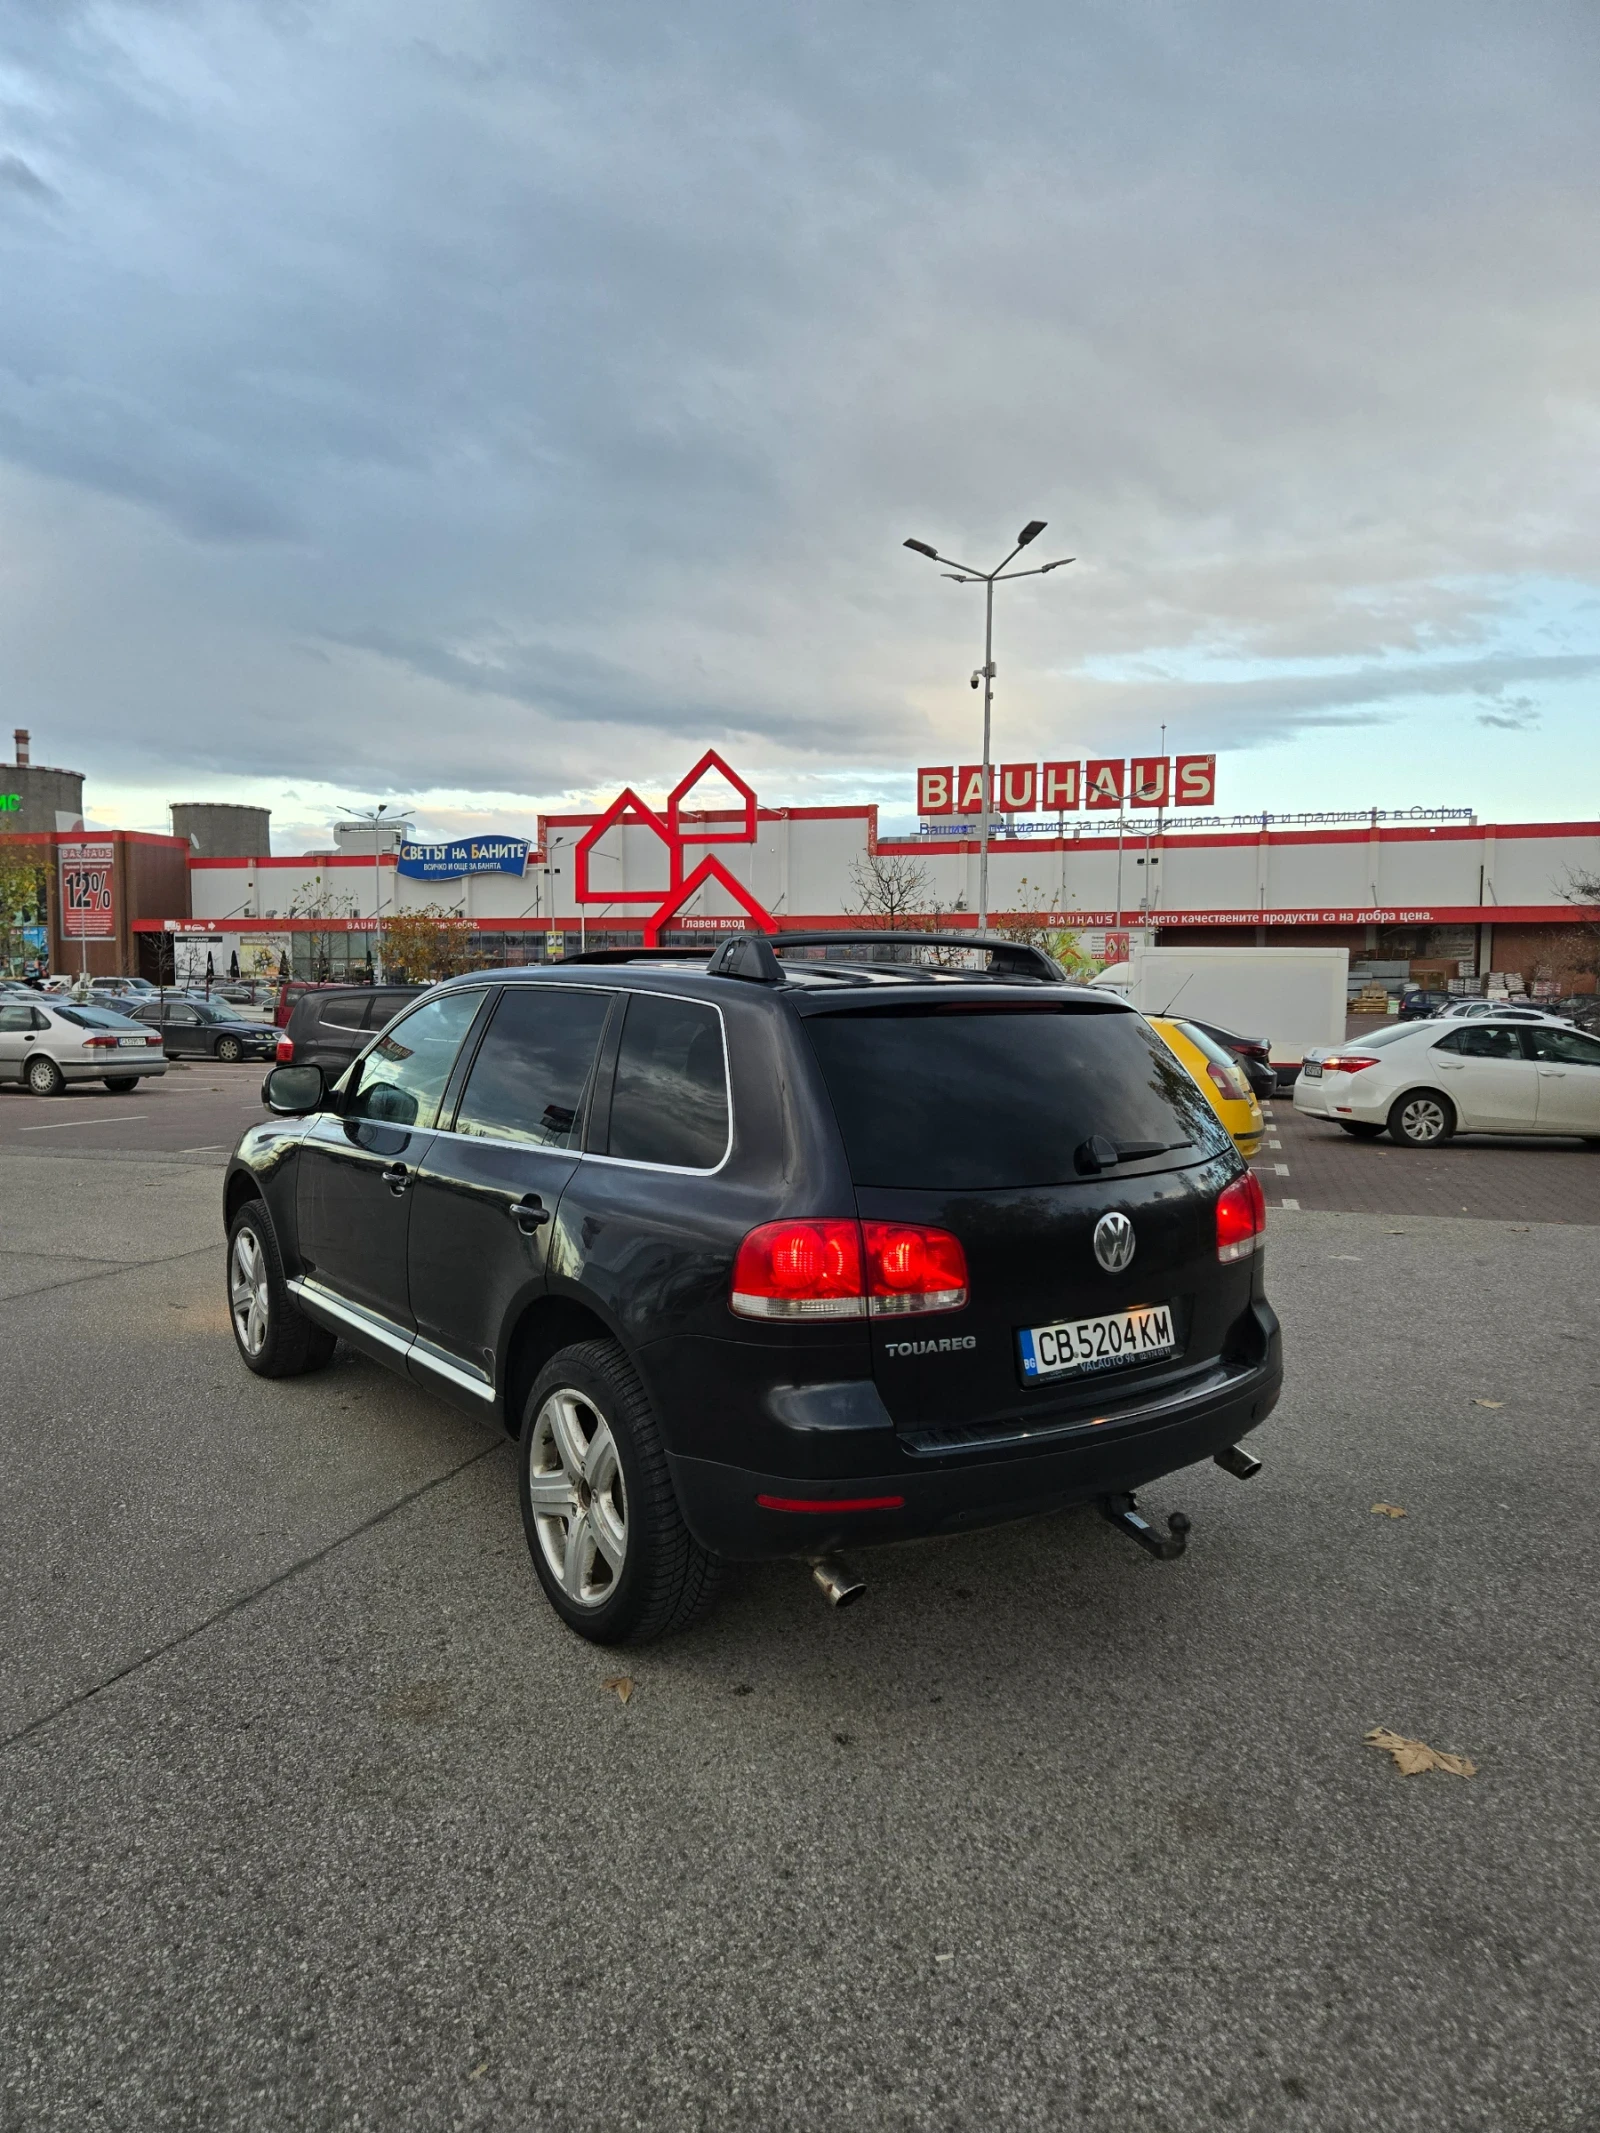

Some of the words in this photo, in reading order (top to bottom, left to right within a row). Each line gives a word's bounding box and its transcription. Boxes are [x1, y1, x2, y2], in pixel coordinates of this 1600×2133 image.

[921, 762, 1211, 809] BAUHAUS
[920, 822, 976, 835] Вашият
[983, 821, 1070, 835] пециалист
[1076, 821, 1092, 831] за
[1231, 814, 1275, 828] дома
[1281, 813, 1291, 823] и
[1298, 811, 1387, 827] градината
[1394, 810, 1403, 820] в
[1410, 804, 1473, 823] София
[401, 845, 448, 861] СВЕТЪТ
[452, 847, 468, 860] НА
[471, 843, 524, 859] БАНИТЕ
[423, 863, 447, 871] ВСИЧКО
[448, 863, 454, 871] И
[454, 863, 468, 872] ОЩЕ
[468, 862, 477, 870] ЗА
[477, 862, 501, 870] БАНЯТА
[65, 871, 111, 910] 12%
[681, 917, 717, 928] Главен
[720, 919, 745, 930] вход
[1049, 914, 1113, 925] BAUHAUS
[1181, 913, 1259, 924] качествените
[1263, 911, 1319, 926] продукти
[1322, 912, 1335, 922] са
[1339, 911, 1354, 922] на
[1357, 909, 1396, 924] добра
[1400, 911, 1433, 923] цена.
[885, 1335, 976, 1357] TOUAREG
[1023, 1357, 1036, 1370] BG
[1079, 1354, 1124, 1373] VALAUTO
